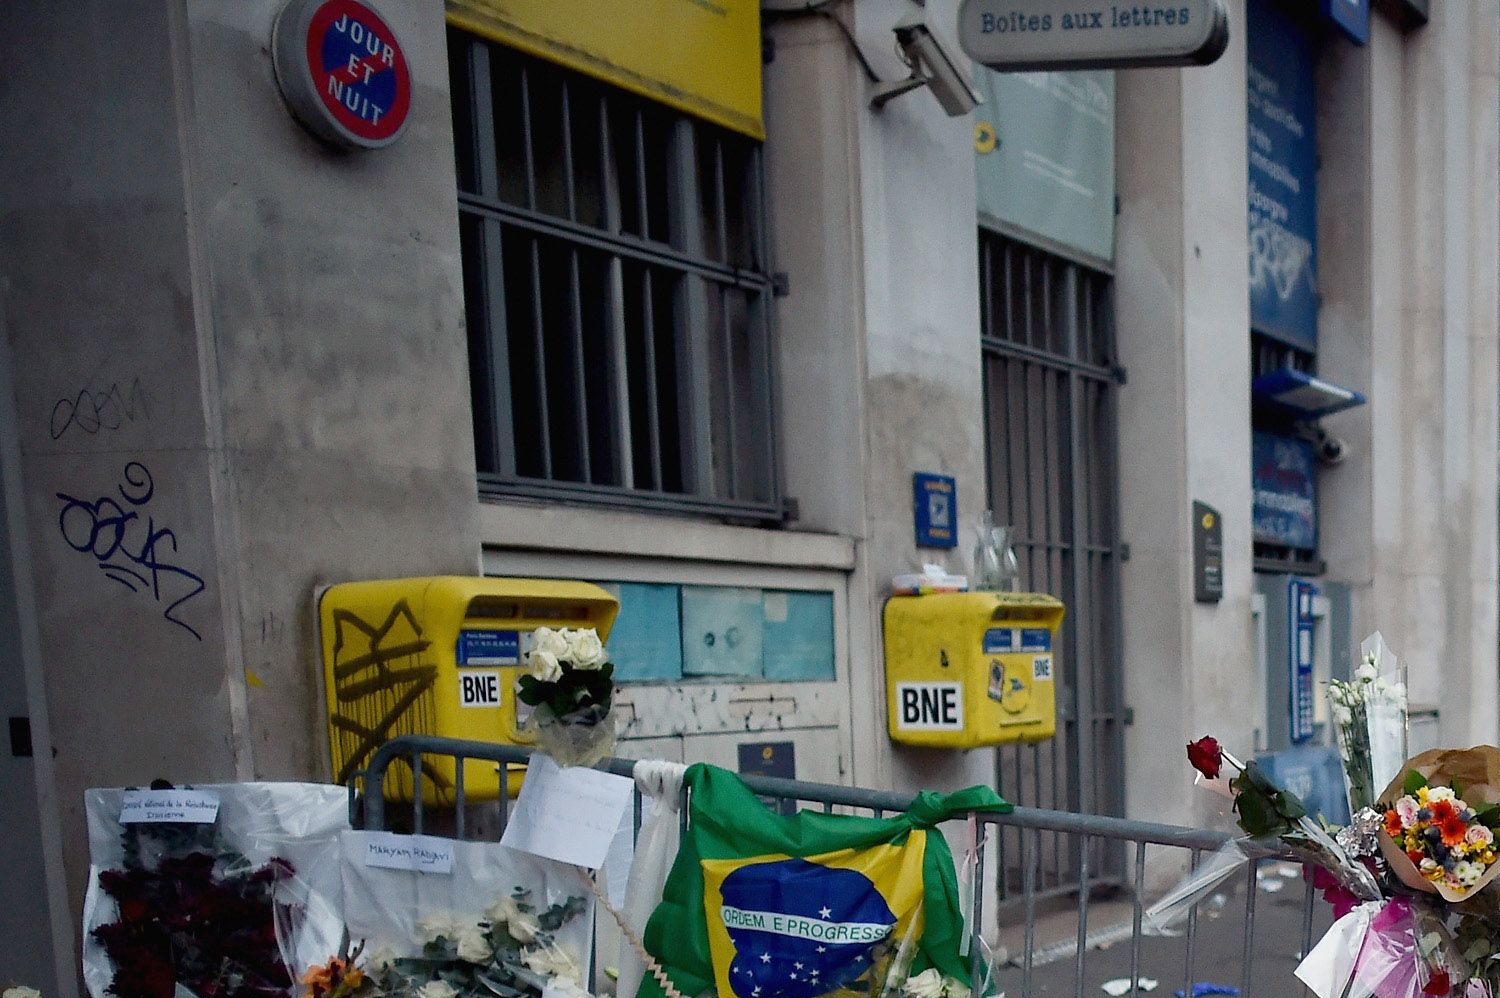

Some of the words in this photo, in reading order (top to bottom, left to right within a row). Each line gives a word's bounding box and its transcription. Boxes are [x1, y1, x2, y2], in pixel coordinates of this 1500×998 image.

[981, 10, 1052, 34] Boîtes
[1061, 12, 1103, 29] aux
[1111, 6, 1190, 28] lettres
[335, 13, 394, 68] JOUR
[347, 53, 375, 85] ET
[328, 75, 383, 126] NUIT
[1034, 659, 1049, 677] BNE
[463, 676, 498, 703] BNE
[902, 687, 957, 723] BNE
[723, 908, 765, 928] ORDEM
[774, 917, 783, 931] E
